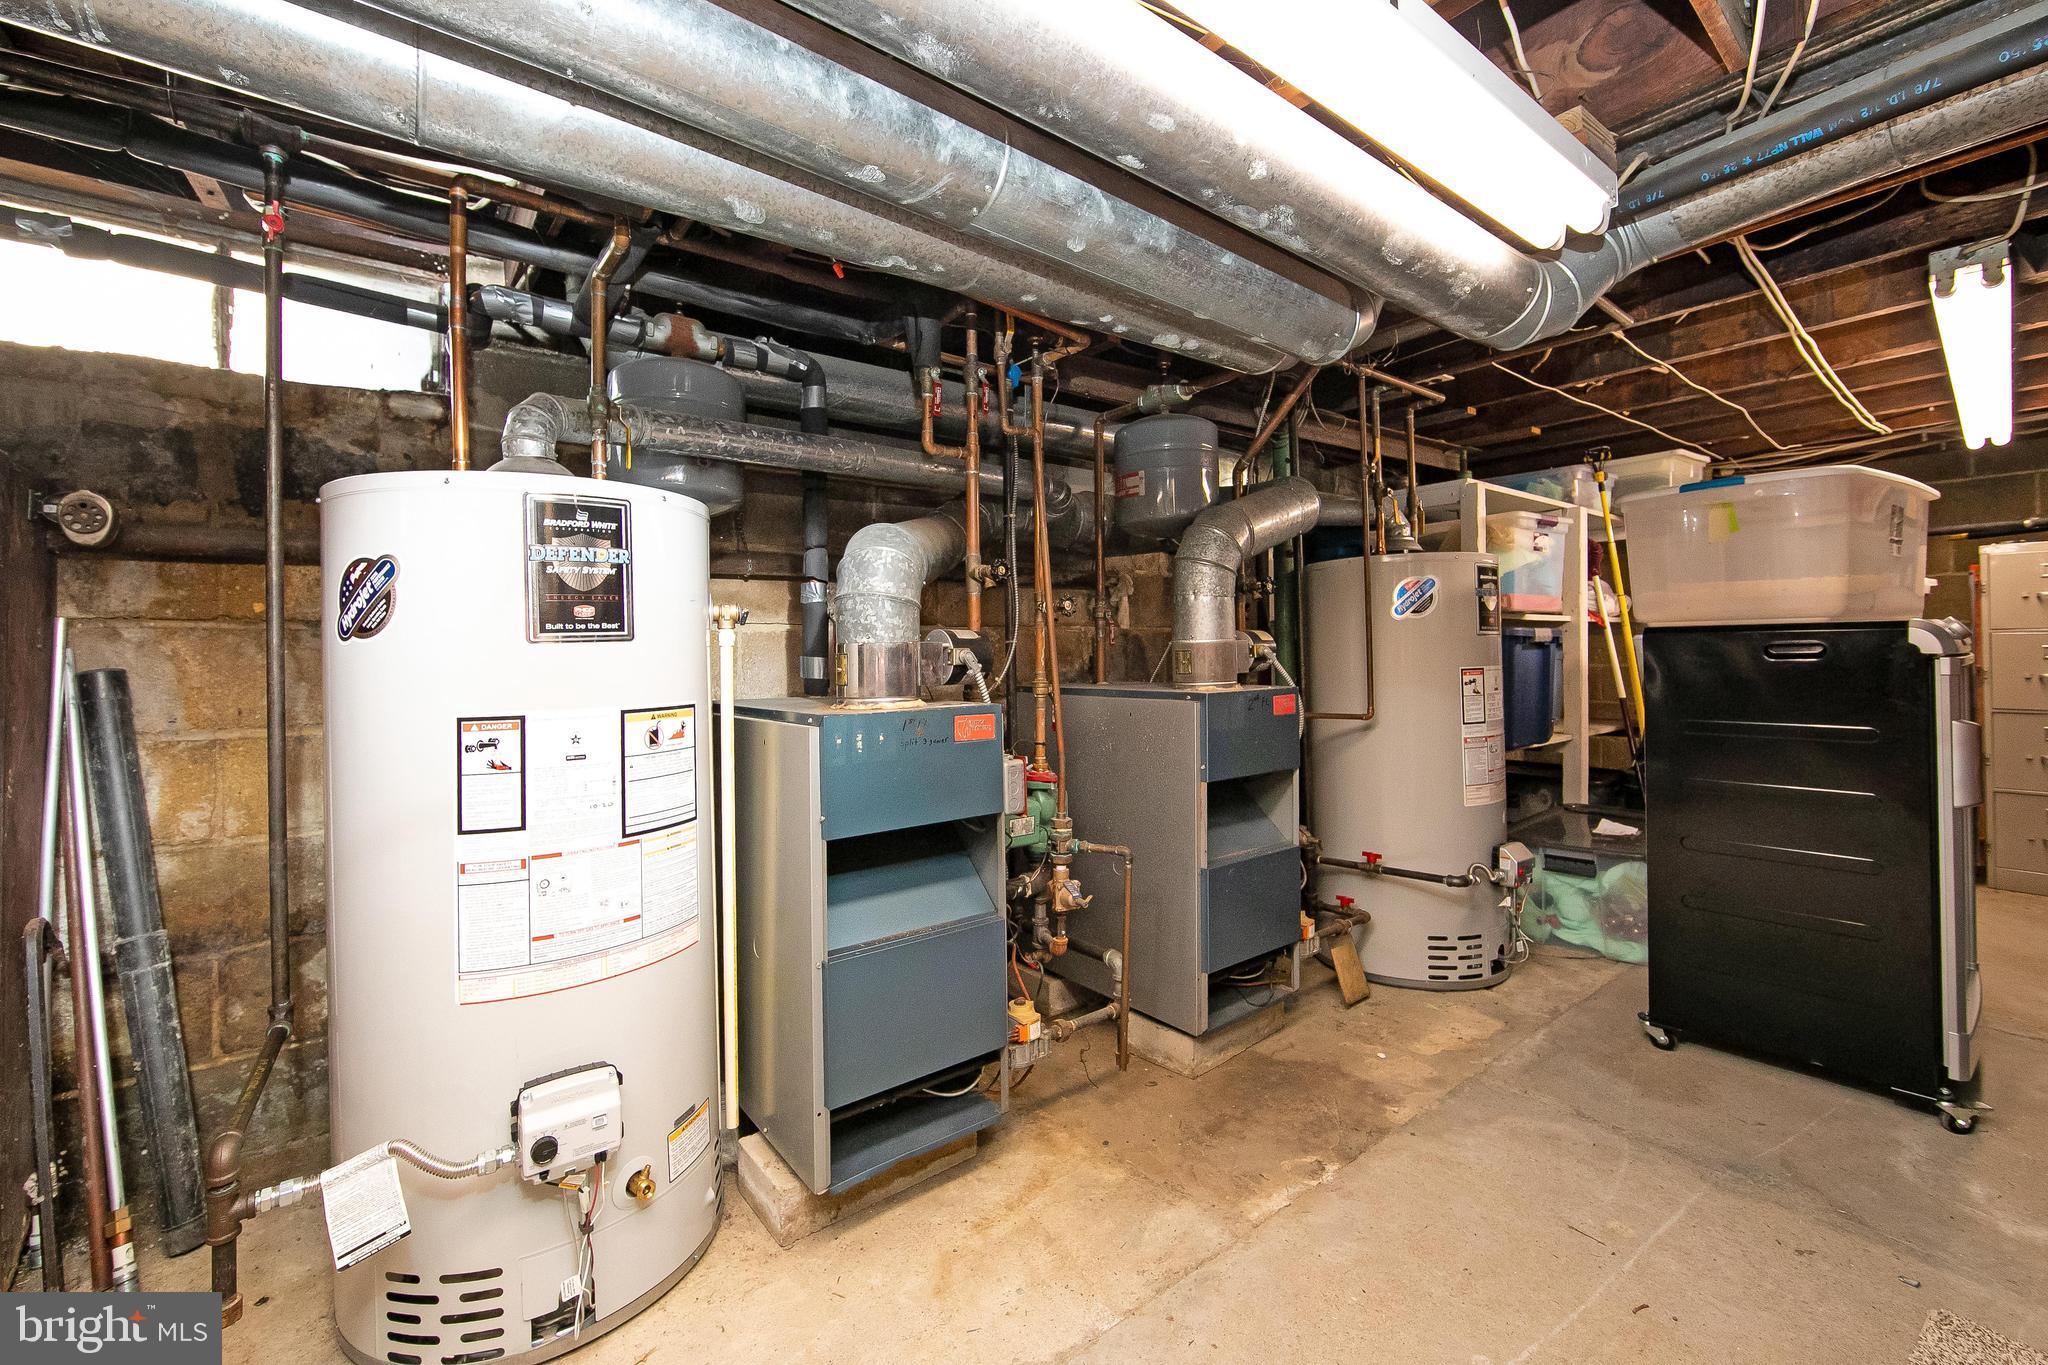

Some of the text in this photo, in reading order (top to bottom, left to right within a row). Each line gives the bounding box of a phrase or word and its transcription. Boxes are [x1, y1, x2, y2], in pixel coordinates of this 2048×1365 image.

[1913, 77, 1942, 95] 7/8
[1789, 127, 1824, 146] WALL
[1646, 190, 1665, 203] 7/8
[543, 518, 618, 530] BRADFORD WHITE
[549, 526, 612, 534] CORPORATION
[529, 544, 631, 564] DEFENDER
[545, 565, 617, 575] SAFETY SYSTEM
[341, 579, 374, 632] Hydrojet
[545, 622, 564, 630] Built
[575, 622, 586, 630] be
[587, 622, 600, 630] the
[601, 622, 620, 630] Best
[656, 711, 678, 719] WARNING
[480, 723, 513, 731] DANGER
